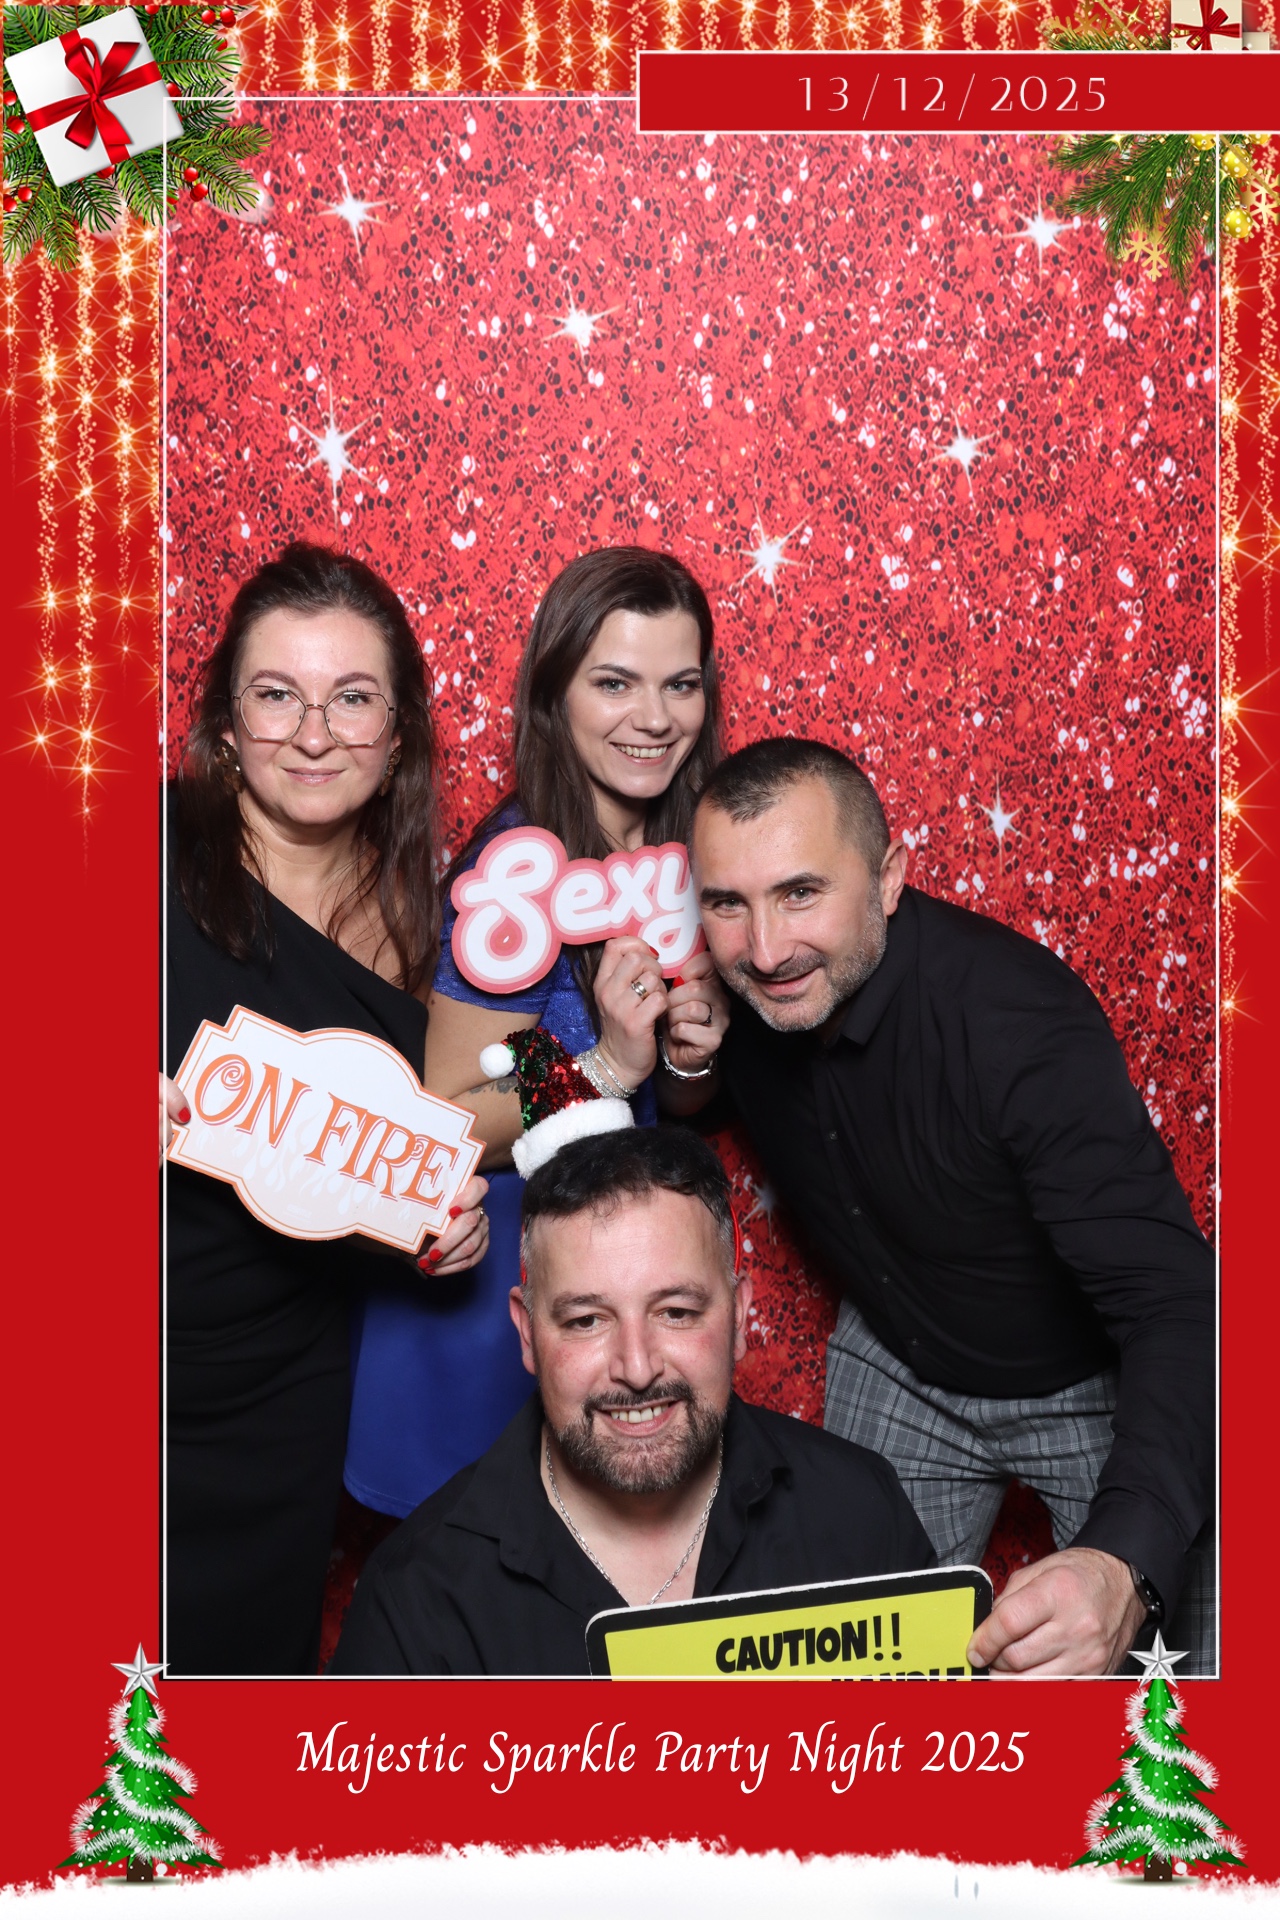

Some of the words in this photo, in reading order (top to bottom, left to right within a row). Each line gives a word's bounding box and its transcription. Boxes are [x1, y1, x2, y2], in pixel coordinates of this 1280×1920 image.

[462, 838, 703, 981] Sexy
[194, 1053, 312, 1149] ON
[303, 1092, 463, 1210] FIRE
[715, 1612, 903, 1674] CAUTION!!
